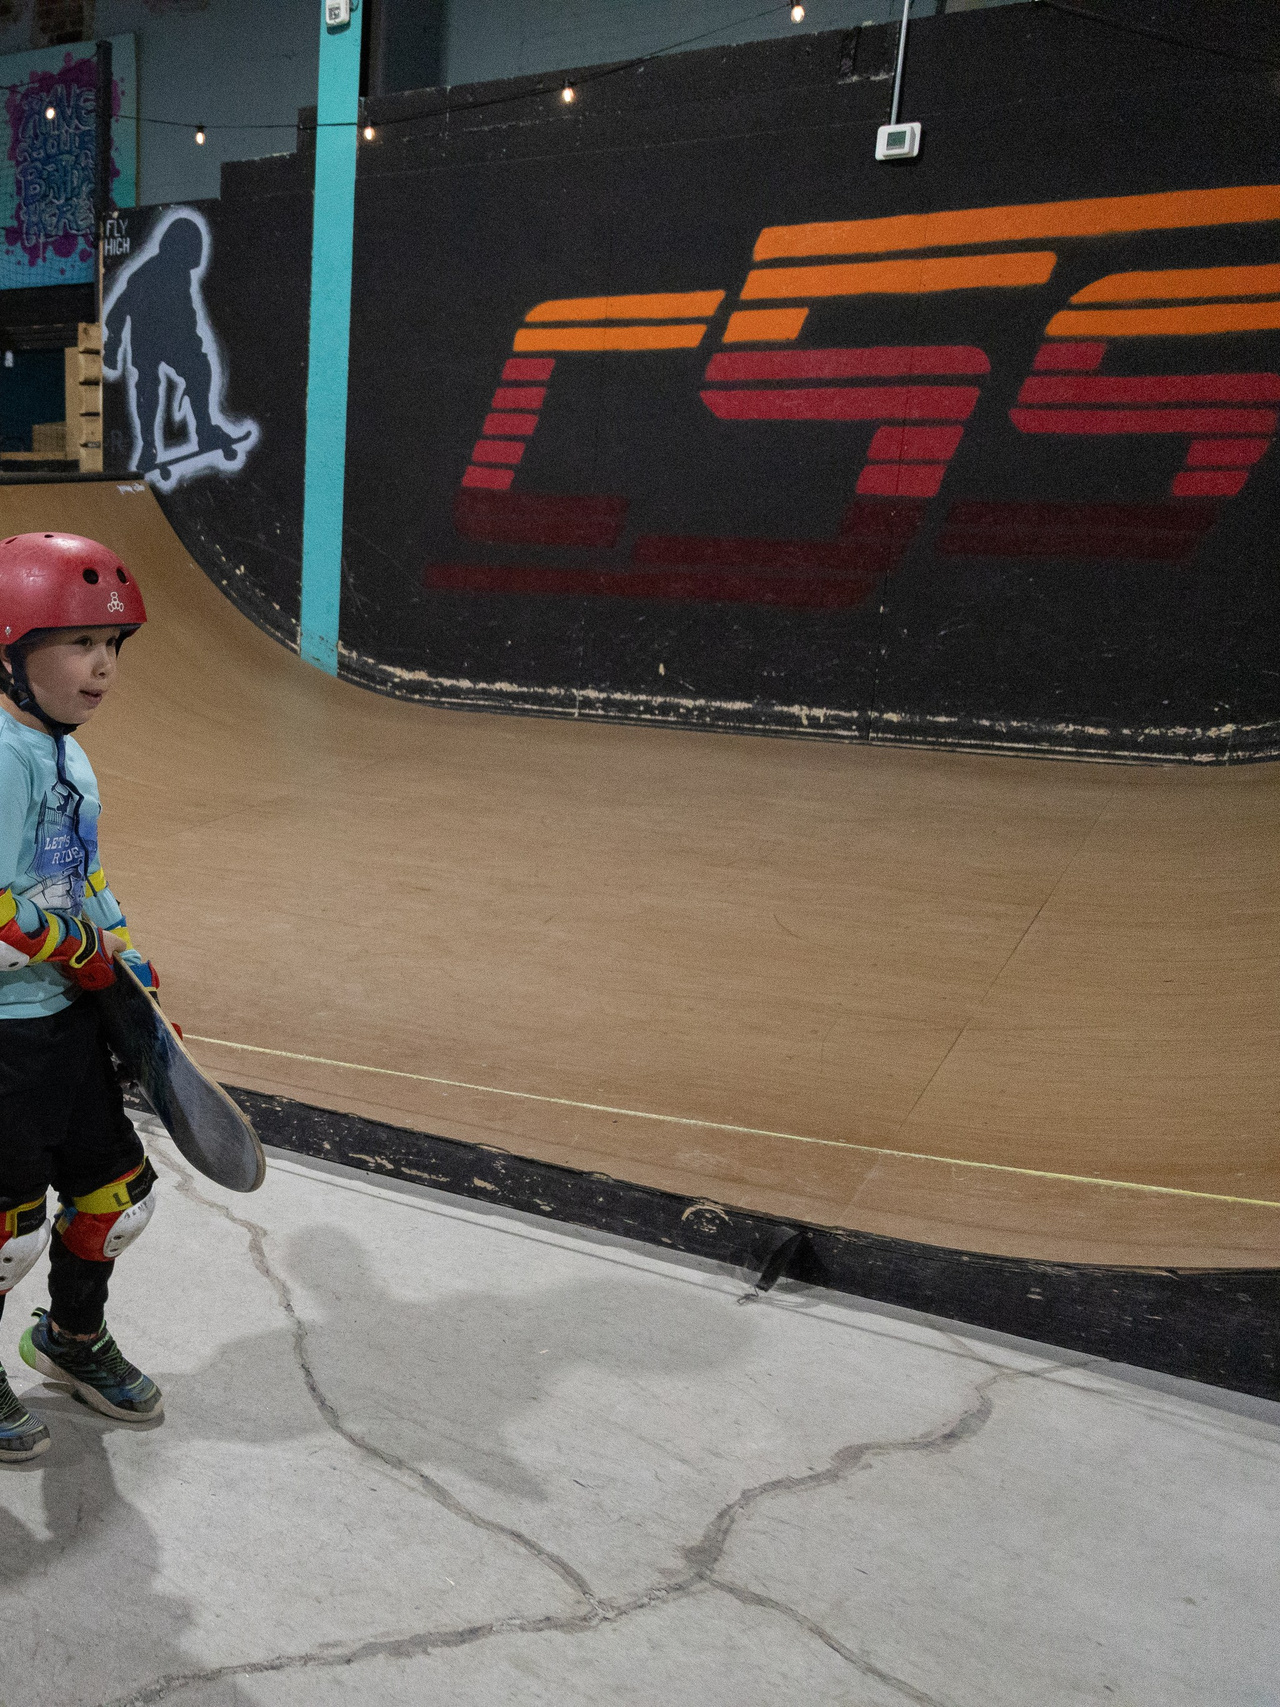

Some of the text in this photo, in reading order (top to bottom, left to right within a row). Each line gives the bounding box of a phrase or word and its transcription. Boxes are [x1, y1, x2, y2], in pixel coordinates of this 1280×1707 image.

[106, 218, 128, 237] FLY
[105, 237, 130, 256] HIGH
[51, 846, 83, 864] RIDE
